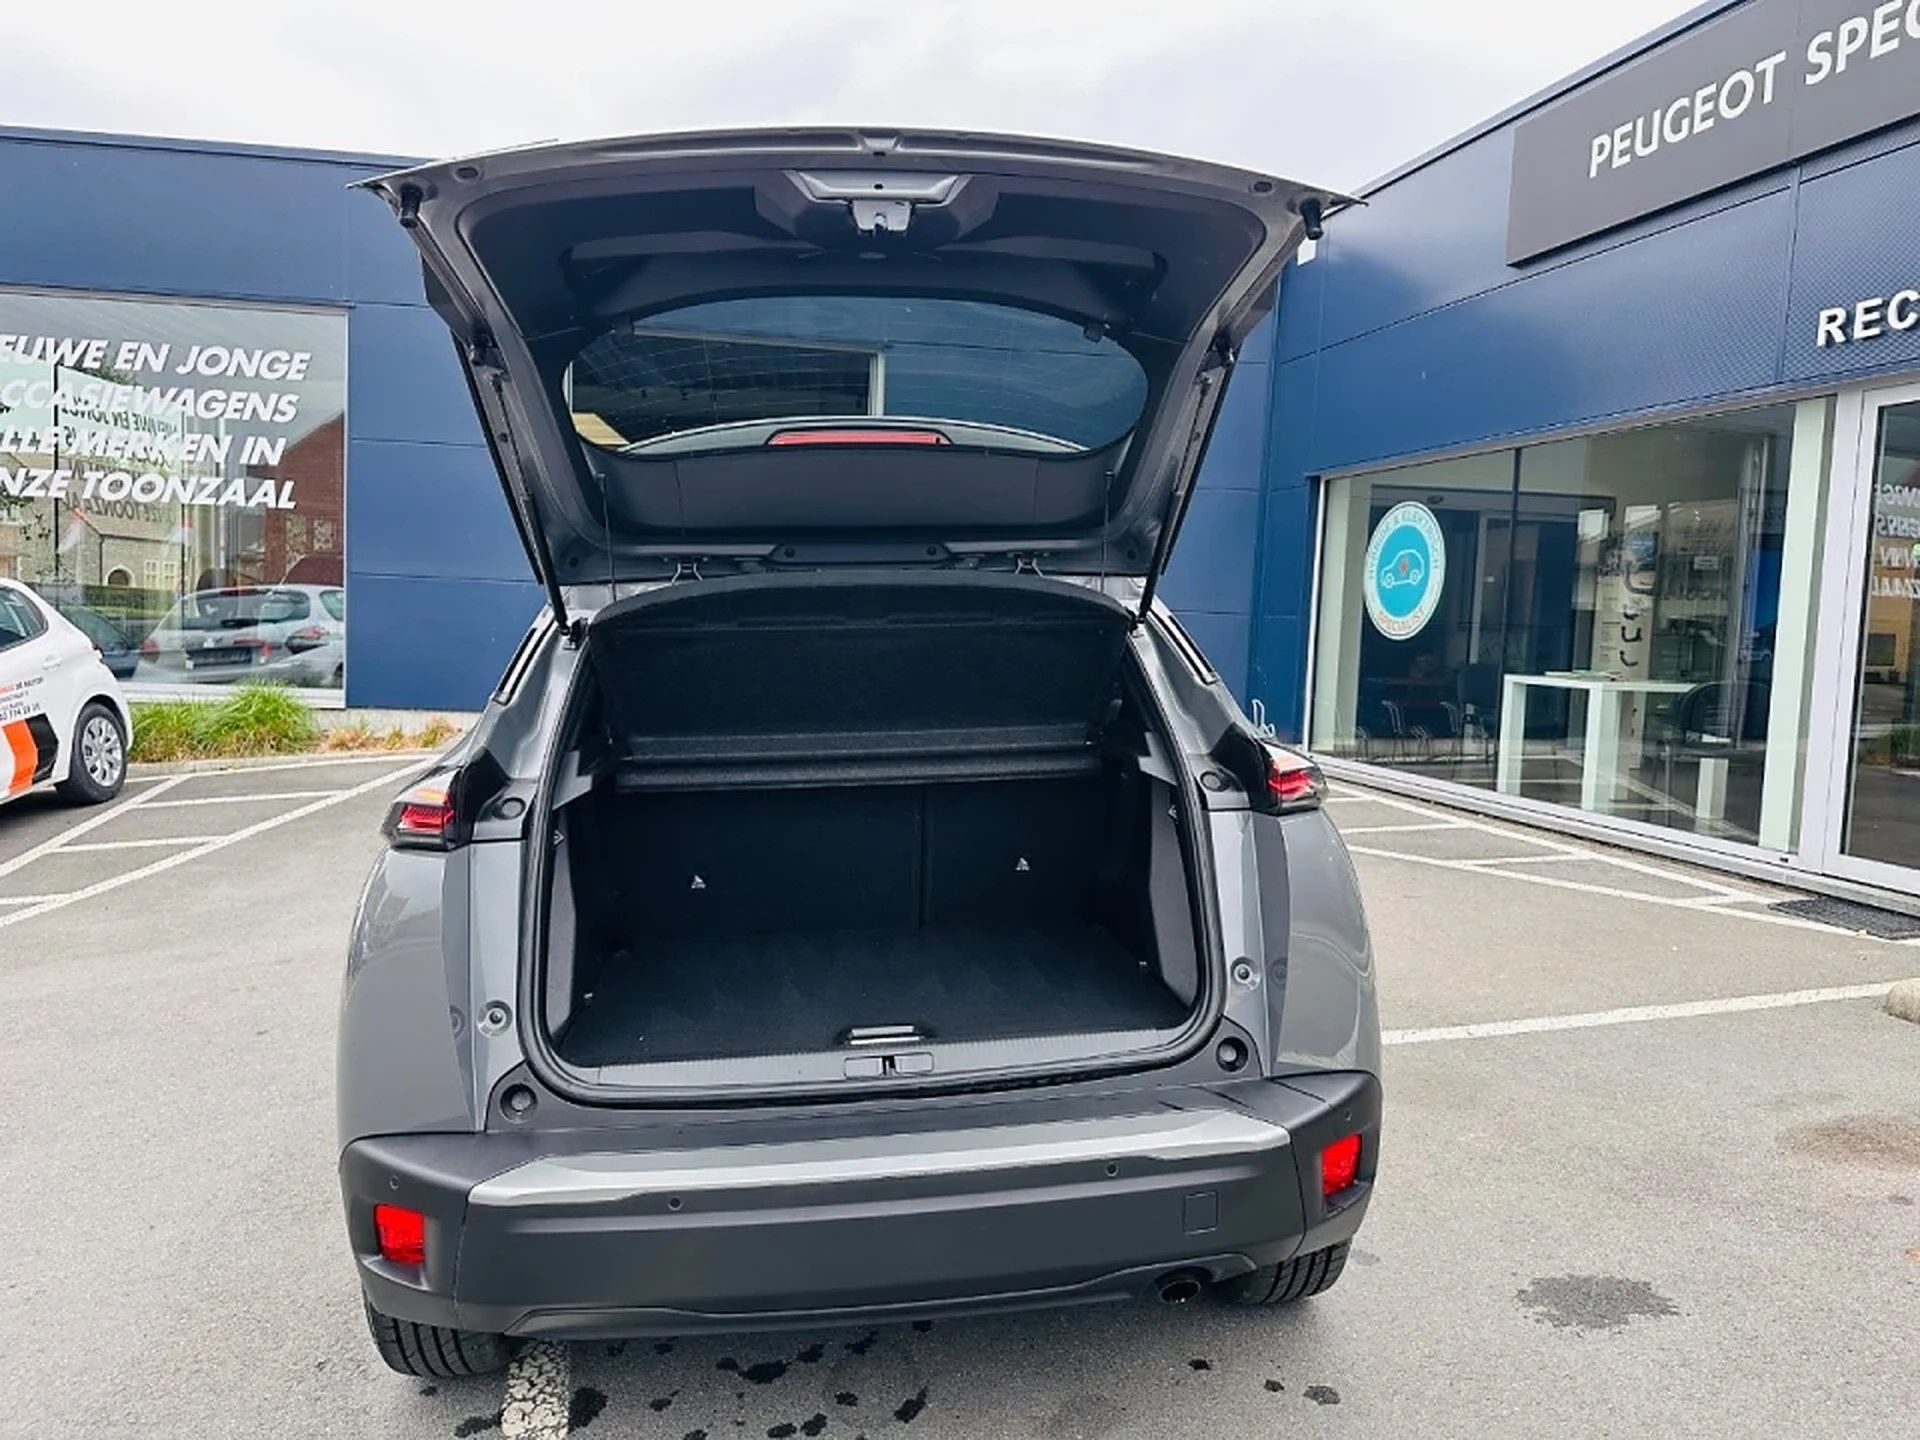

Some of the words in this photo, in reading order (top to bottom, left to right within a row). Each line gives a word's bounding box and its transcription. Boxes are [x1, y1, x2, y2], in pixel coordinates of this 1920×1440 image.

[1588, 51, 1787, 178] PEUGEOT
[1817, 289, 1920, 347] REC
[114, 341, 172, 373] EN
[175, 345, 312, 381] JONGE
[239, 436, 287, 467] IN
[81, 471, 297, 509] TOONZAAL
